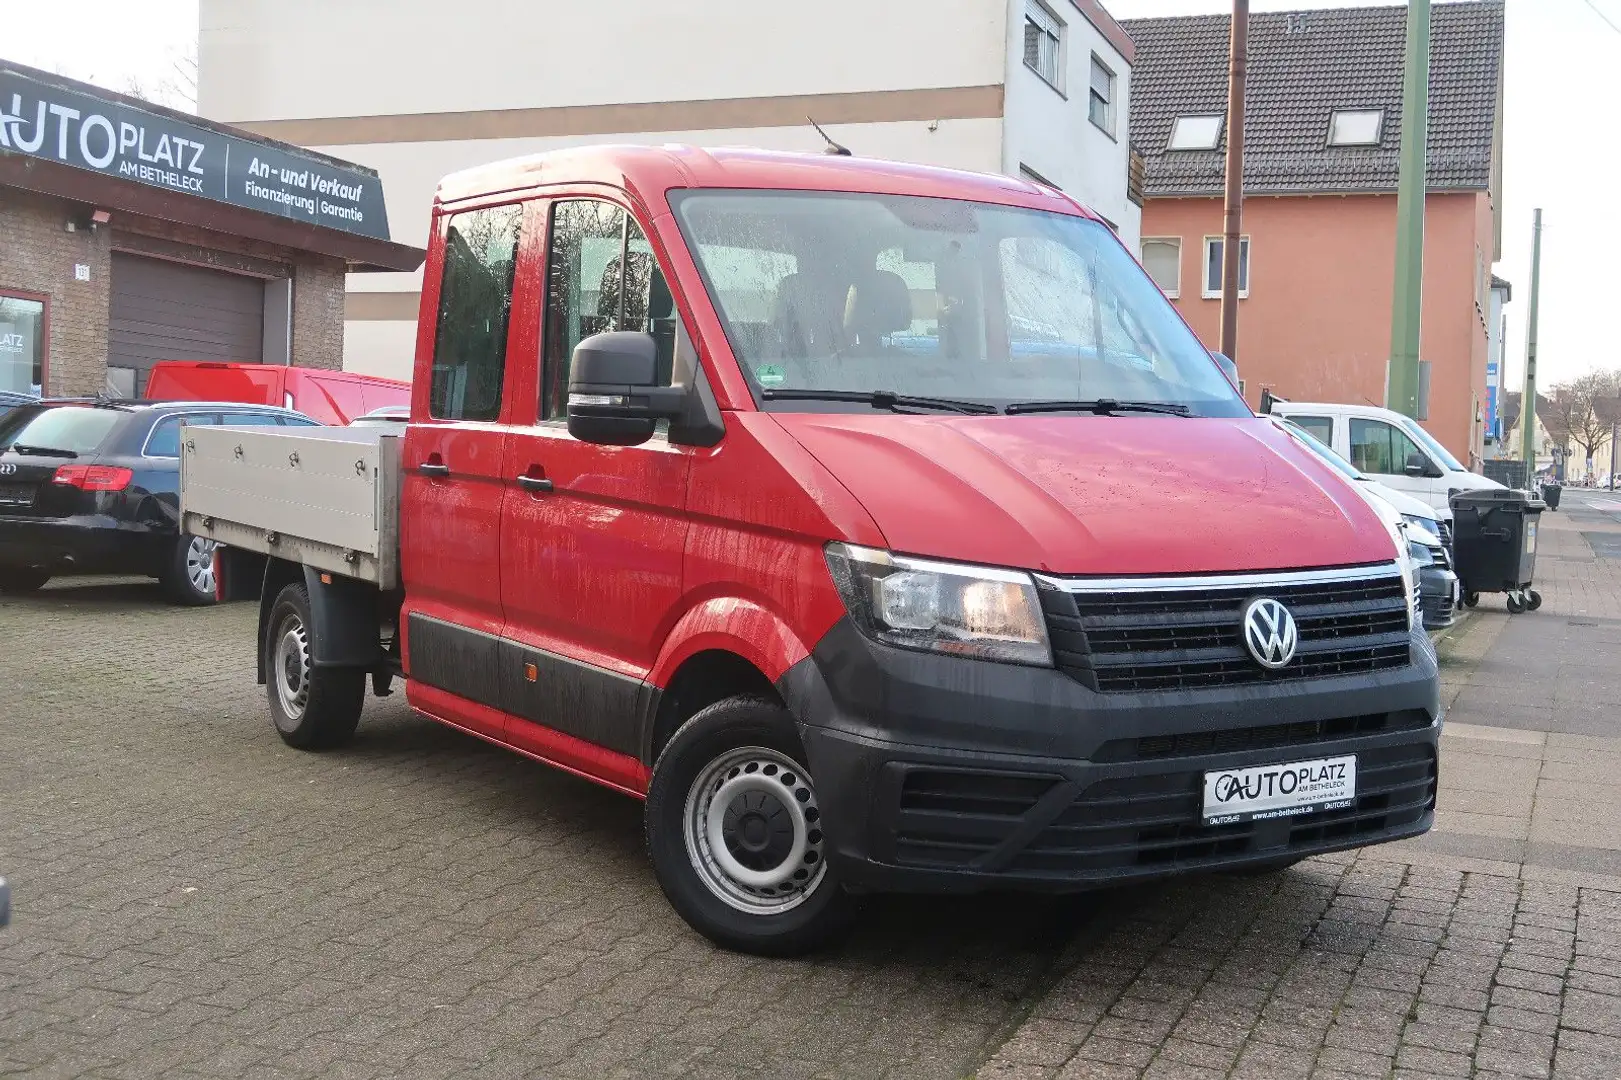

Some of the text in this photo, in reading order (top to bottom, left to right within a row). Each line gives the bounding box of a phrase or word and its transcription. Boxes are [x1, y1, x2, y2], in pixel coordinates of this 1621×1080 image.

[119, 160, 203, 192] AM BETHELECK
[280, 168, 308, 188] und
[311, 173, 363, 202] Verkauf
[245, 181, 363, 221] Finanzierung Garantie
[1245, 599, 1297, 668] VW
[1298, 781, 1346, 793] AM BETHELECK
